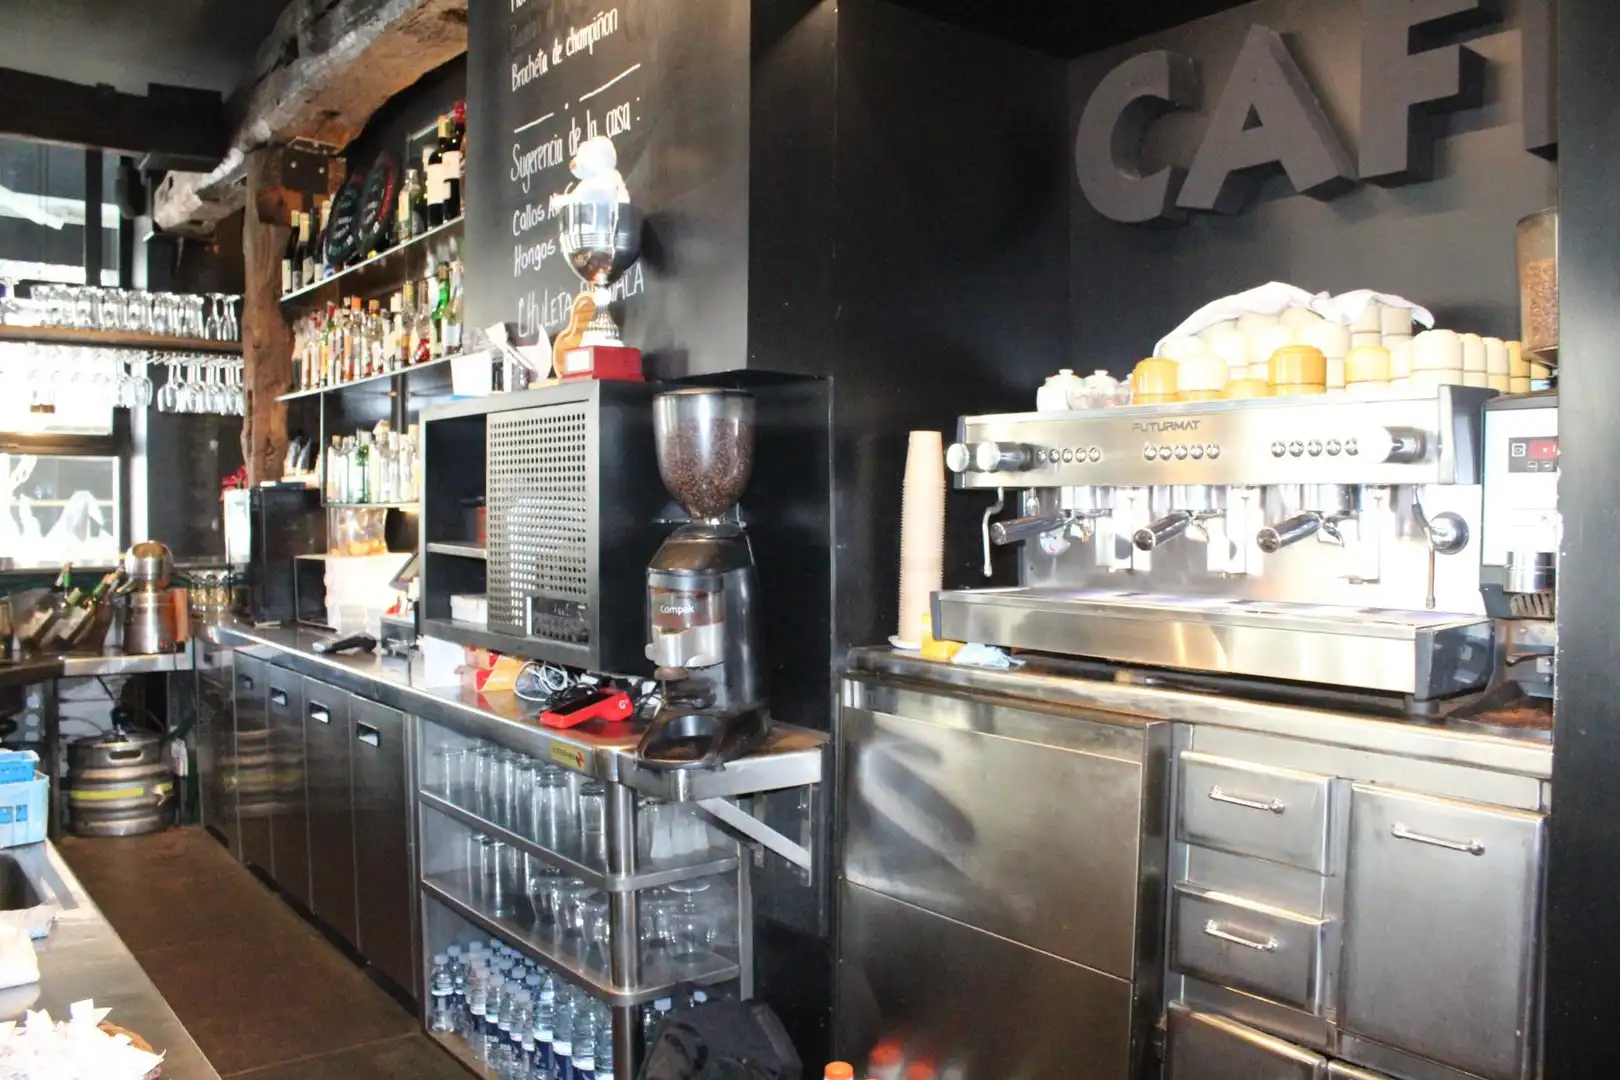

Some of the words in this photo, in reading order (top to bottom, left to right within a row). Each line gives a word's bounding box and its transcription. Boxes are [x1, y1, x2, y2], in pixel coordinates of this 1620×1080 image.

[511, 48, 548, 92] Brocheta
[551, 37, 563, 65] de
[510, 133, 563, 194] Sugerencia
[568, 117, 581, 157] de
[512, 203, 545, 236] Callos
[513, 239, 556, 278] Hongos
[1132, 419, 1201, 433] FUTURMAT
